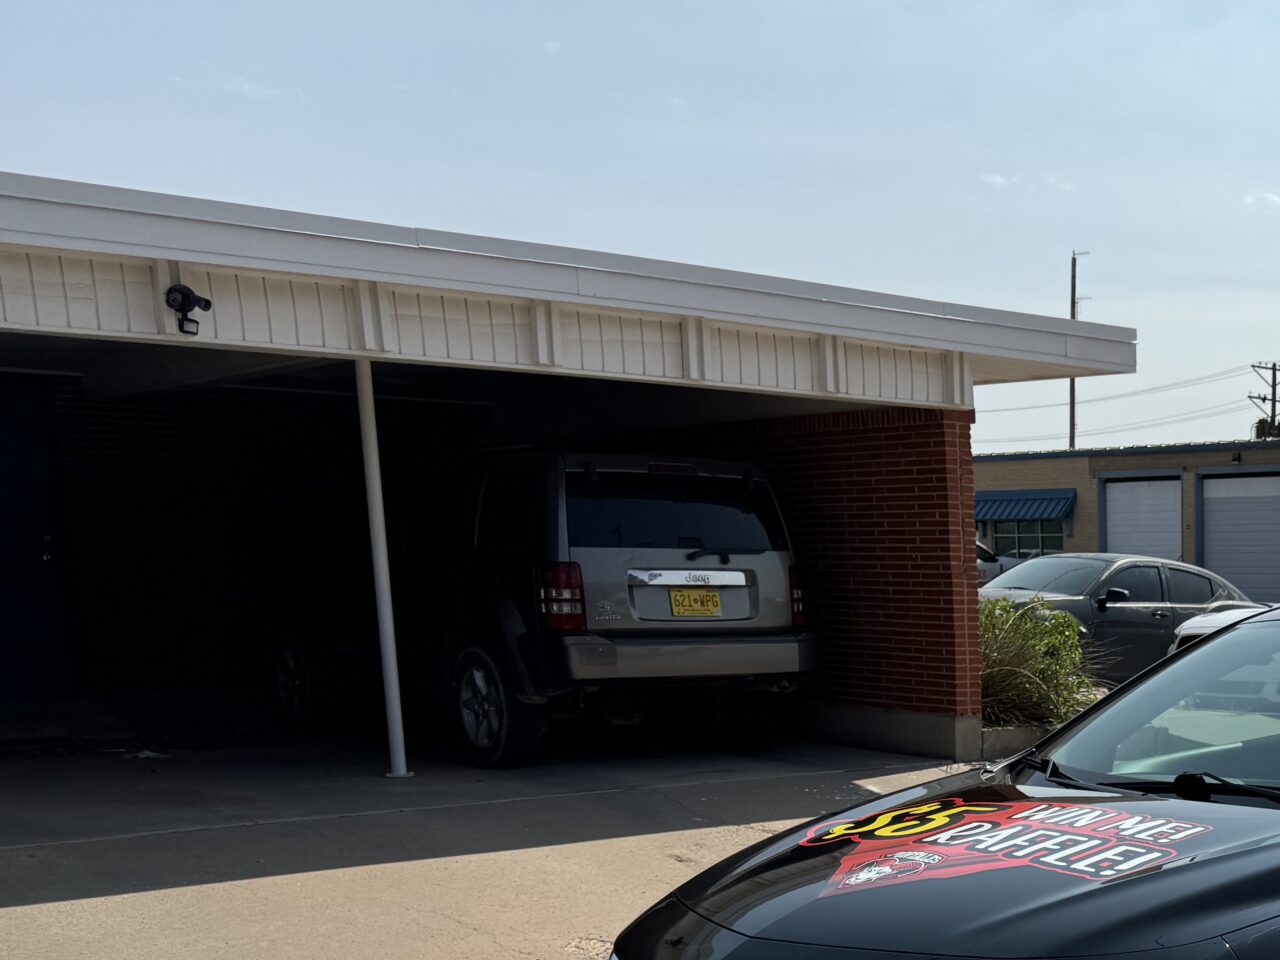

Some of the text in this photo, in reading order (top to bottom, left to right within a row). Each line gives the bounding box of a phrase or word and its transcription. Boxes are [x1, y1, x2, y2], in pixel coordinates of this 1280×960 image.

[685, 572, 711, 585] Jeep
[822, 802, 998, 840] $5
[1012, 804, 1205, 843] WIN ME!
[922, 822, 1162, 876] RAFFLE!
